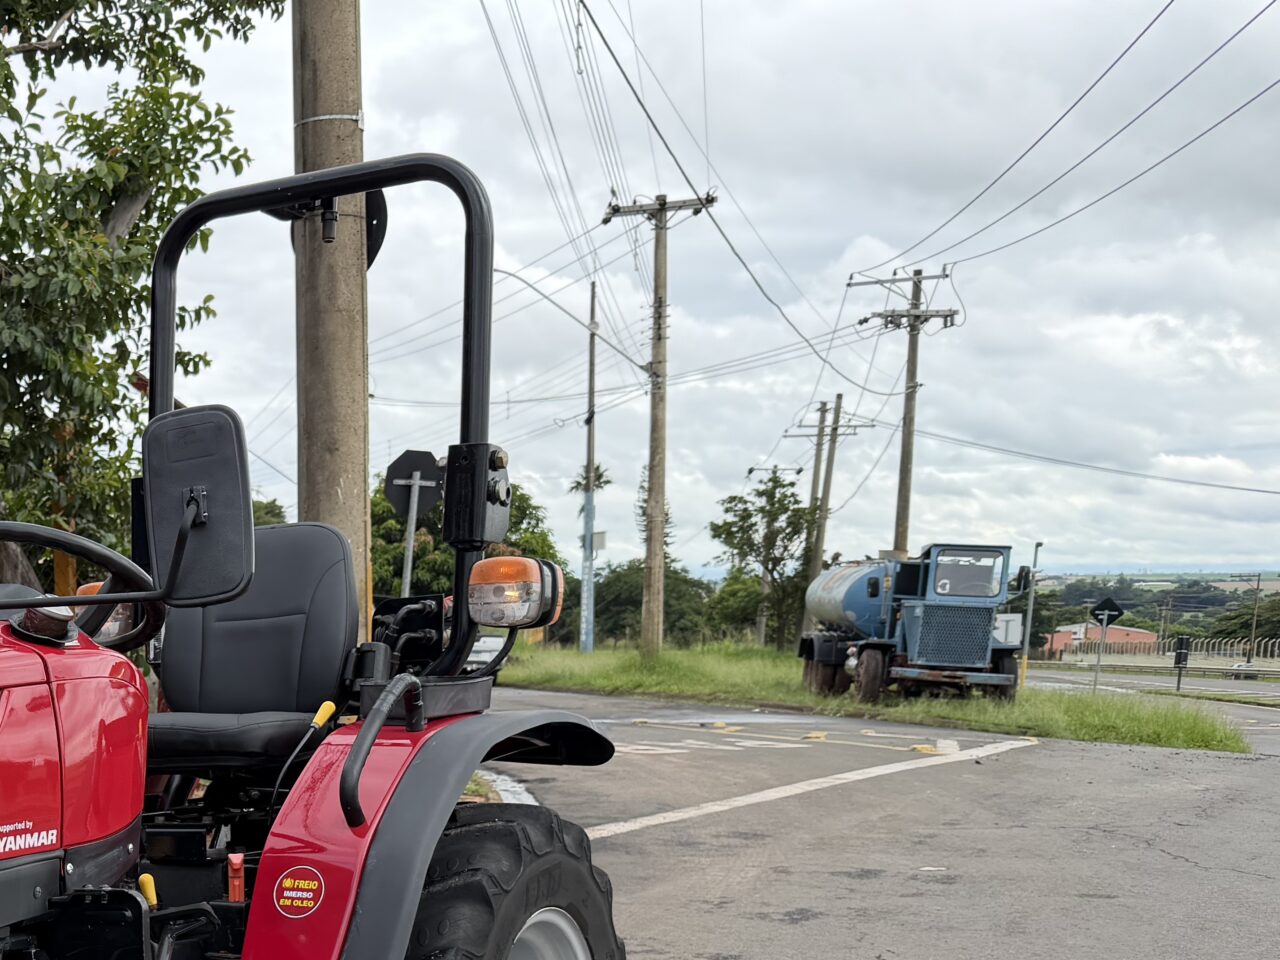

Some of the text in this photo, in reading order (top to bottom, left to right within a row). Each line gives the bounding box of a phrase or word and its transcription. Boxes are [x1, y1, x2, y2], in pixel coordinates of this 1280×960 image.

[22, 820, 33, 830] by
[294, 880, 318, 890] FREIO
[283, 890, 313, 899] IMERSO
[279, 898, 291, 906] EM
